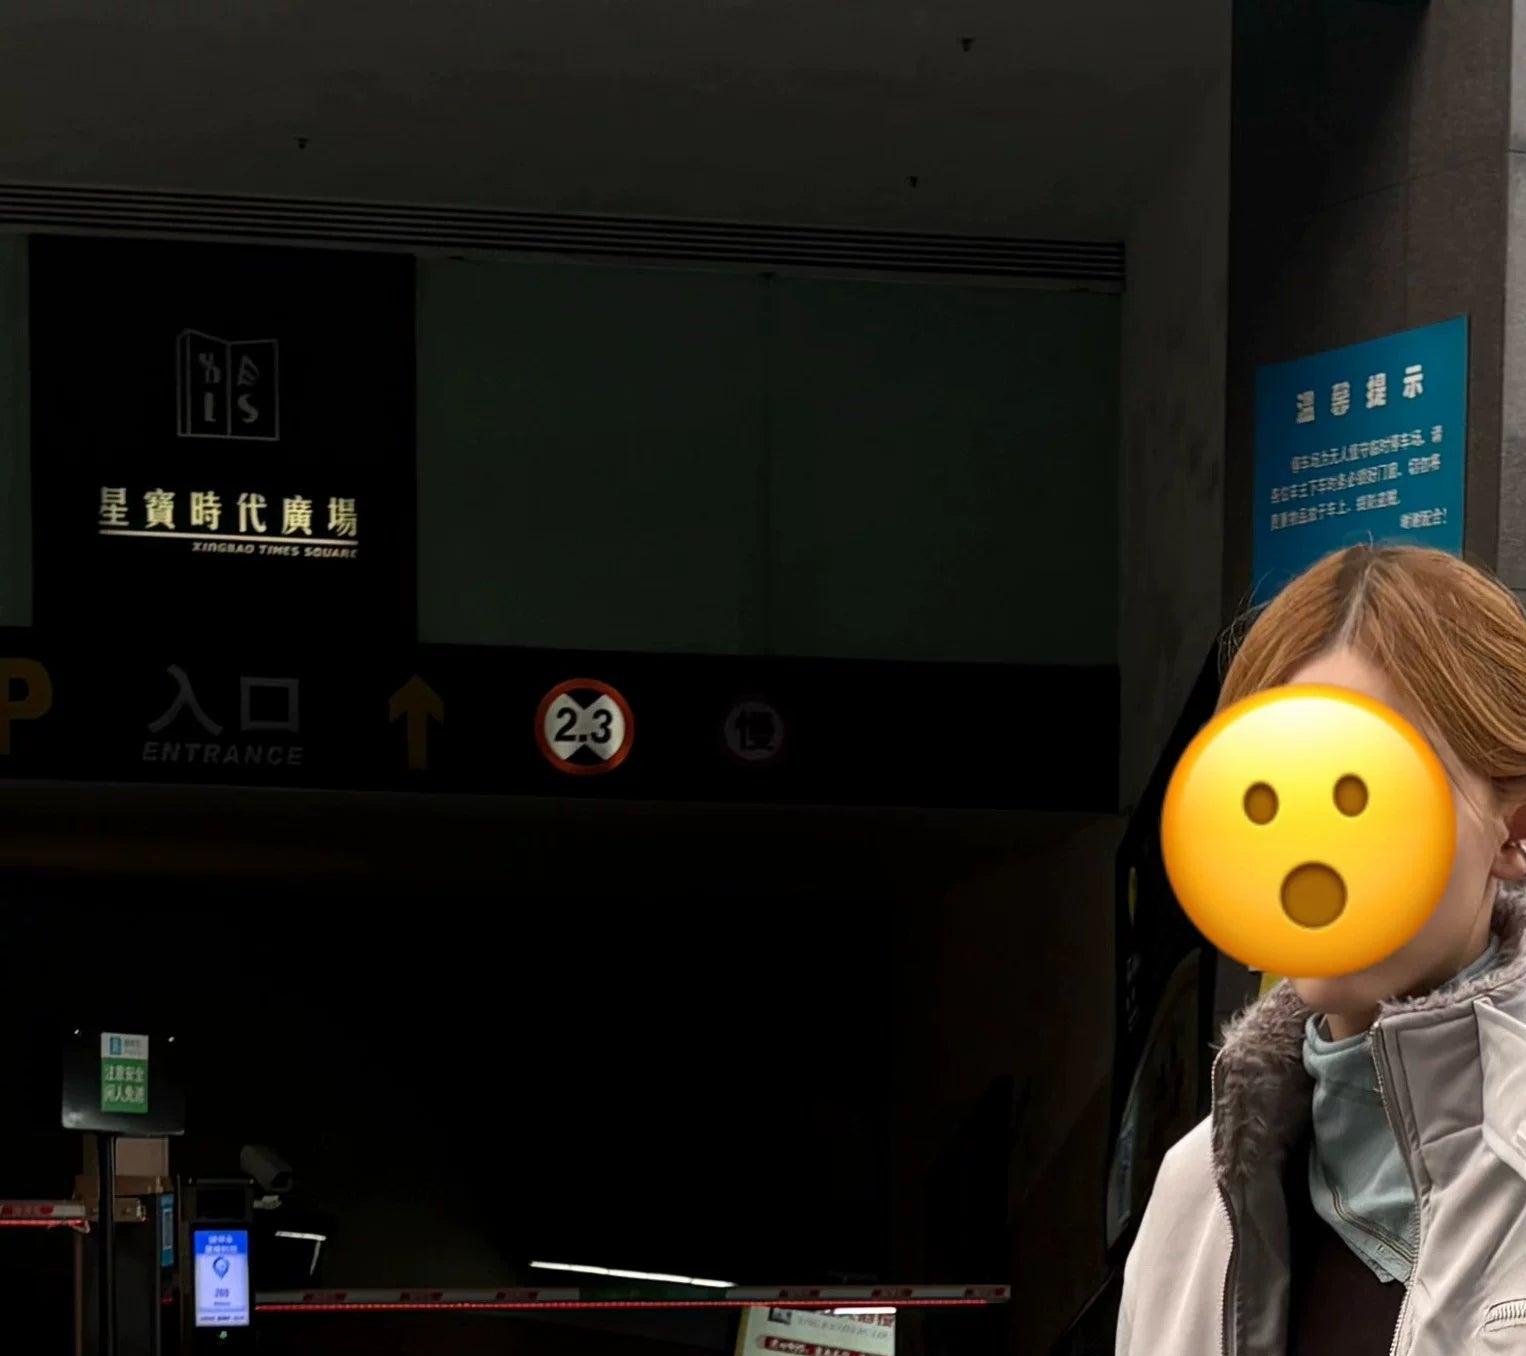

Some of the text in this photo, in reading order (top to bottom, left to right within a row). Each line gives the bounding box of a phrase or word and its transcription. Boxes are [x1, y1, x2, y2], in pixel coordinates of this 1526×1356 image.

[1296, 364, 1424, 423] 温馨提示
[98, 487, 358, 537] 星寶時代廣場
[259, 544, 300, 557] TIMES
[304, 546, 358, 560] SQUARE
[147, 663, 300, 736] 入口
[555, 707, 612, 743] 2.3
[142, 741, 304, 766] ENTRANCE
